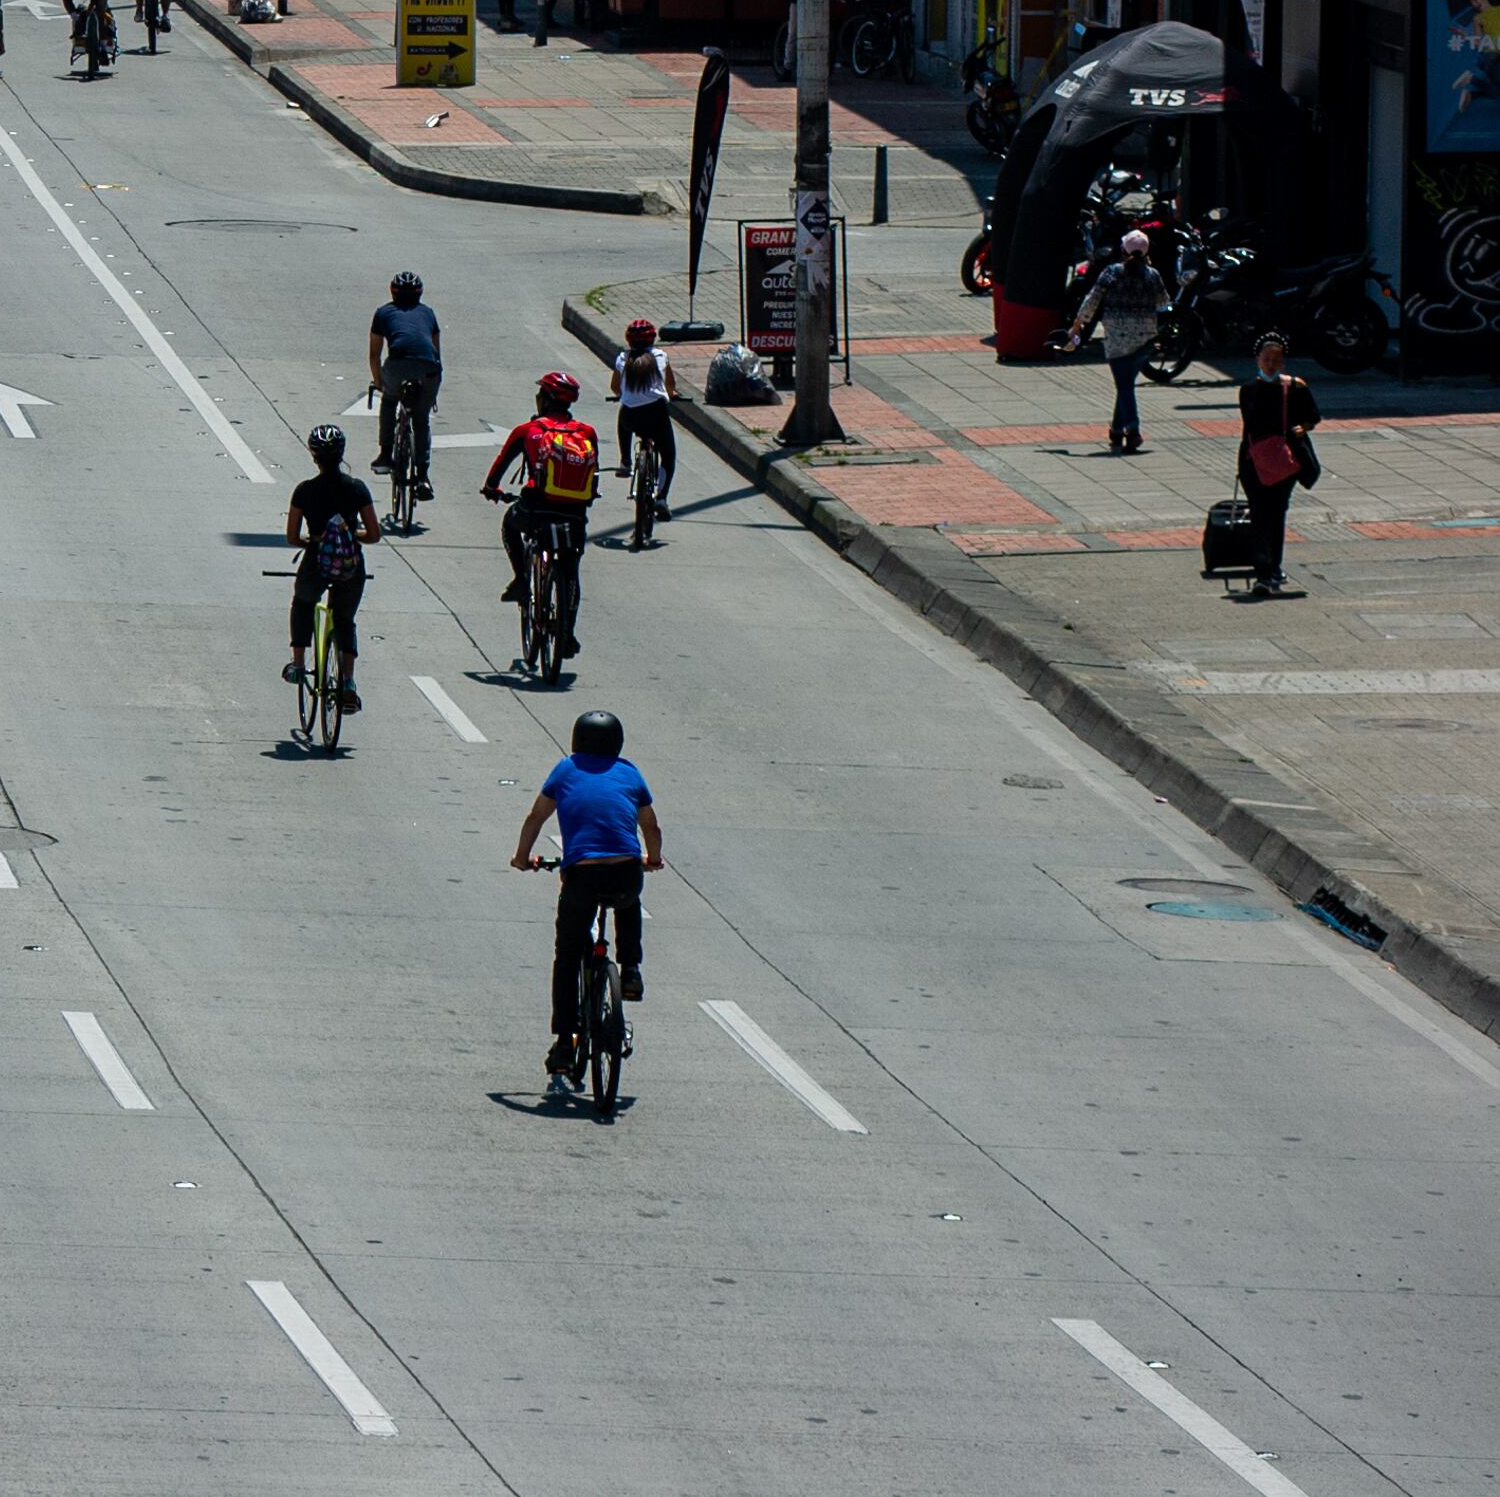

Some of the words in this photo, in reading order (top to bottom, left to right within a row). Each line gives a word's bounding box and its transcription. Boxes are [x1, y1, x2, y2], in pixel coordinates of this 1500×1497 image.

[1130, 88, 1186, 106] TVS
[695, 148, 714, 224] TVS
[751, 230, 790, 244] GRAN
[767, 247, 796, 256] COMER
[773, 311, 796, 319] NUEST
